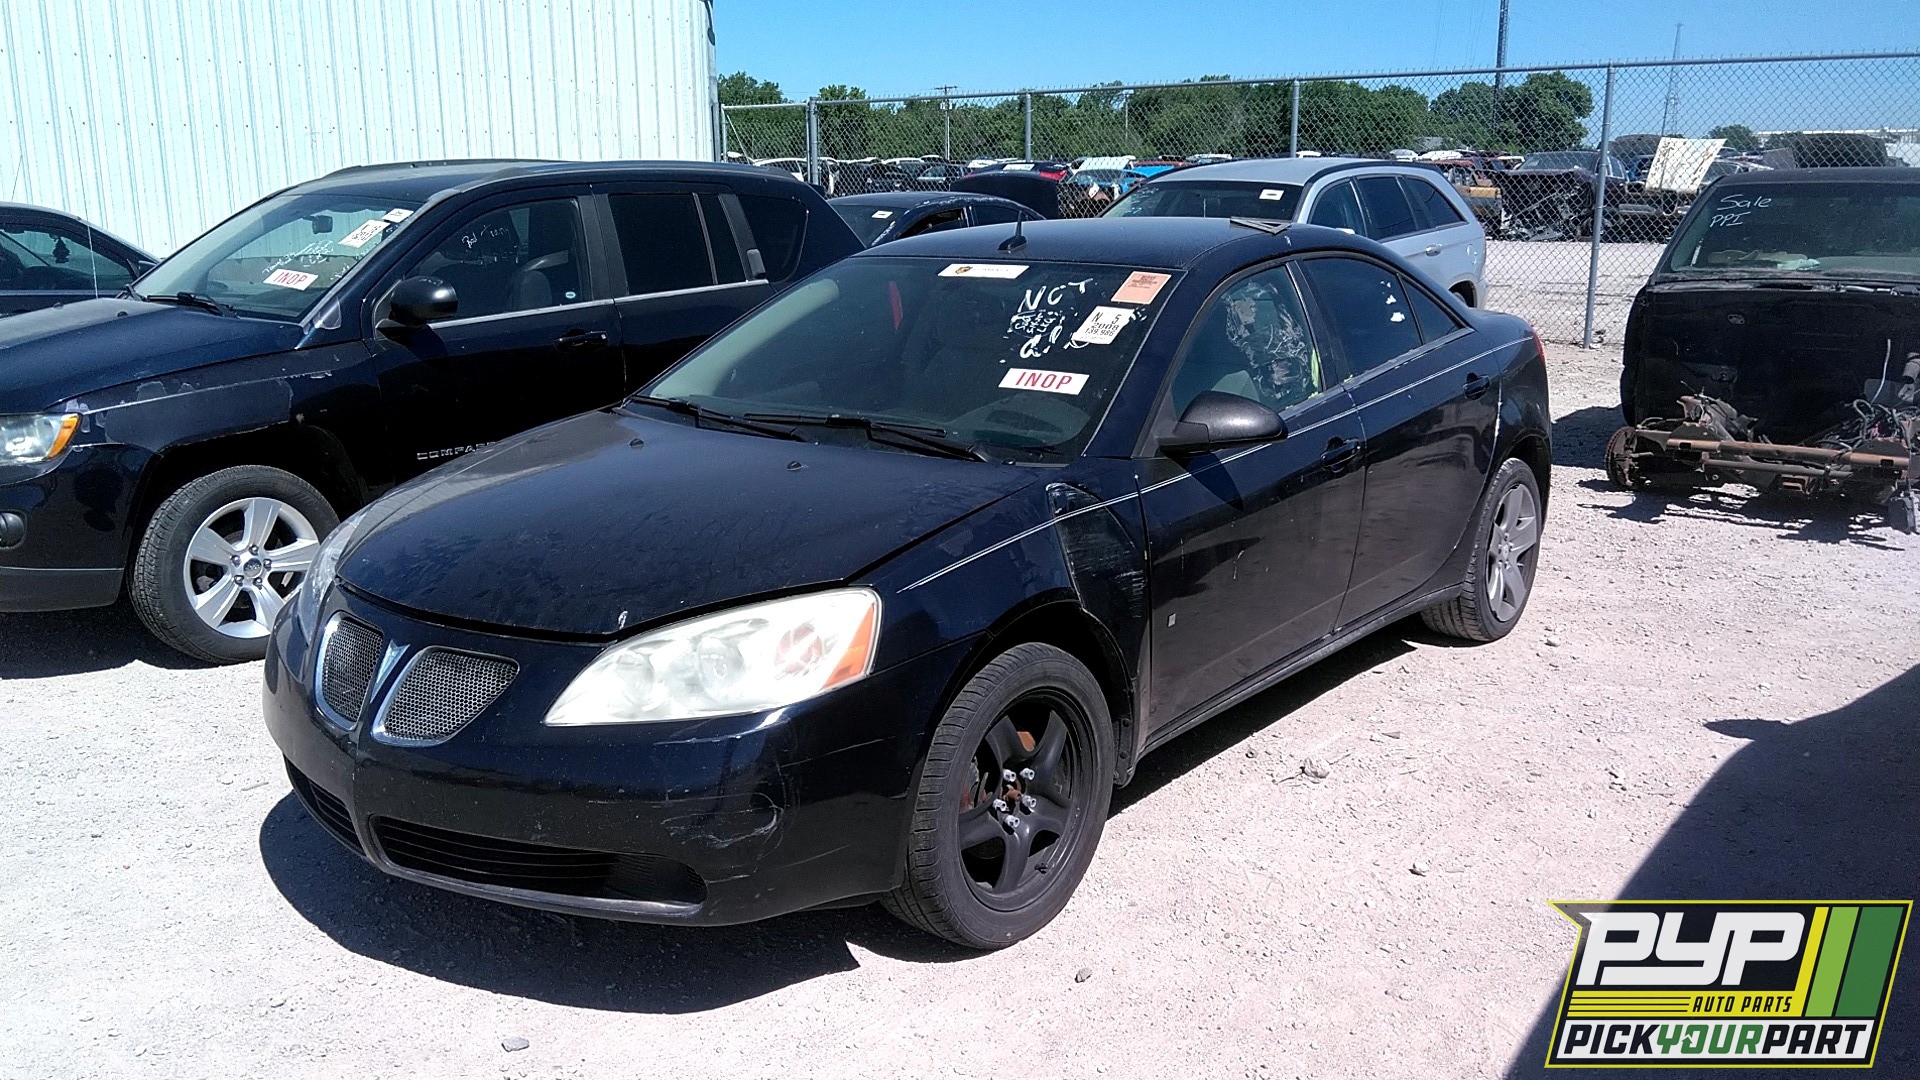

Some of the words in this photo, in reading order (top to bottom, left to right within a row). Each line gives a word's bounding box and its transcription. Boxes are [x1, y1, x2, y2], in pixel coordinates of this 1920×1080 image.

[1717, 194, 1772, 211] Sale
[273, 271, 308, 286] INOP
[1090, 322, 1120, 331] 2008
[1015, 371, 1073, 390] INOP
